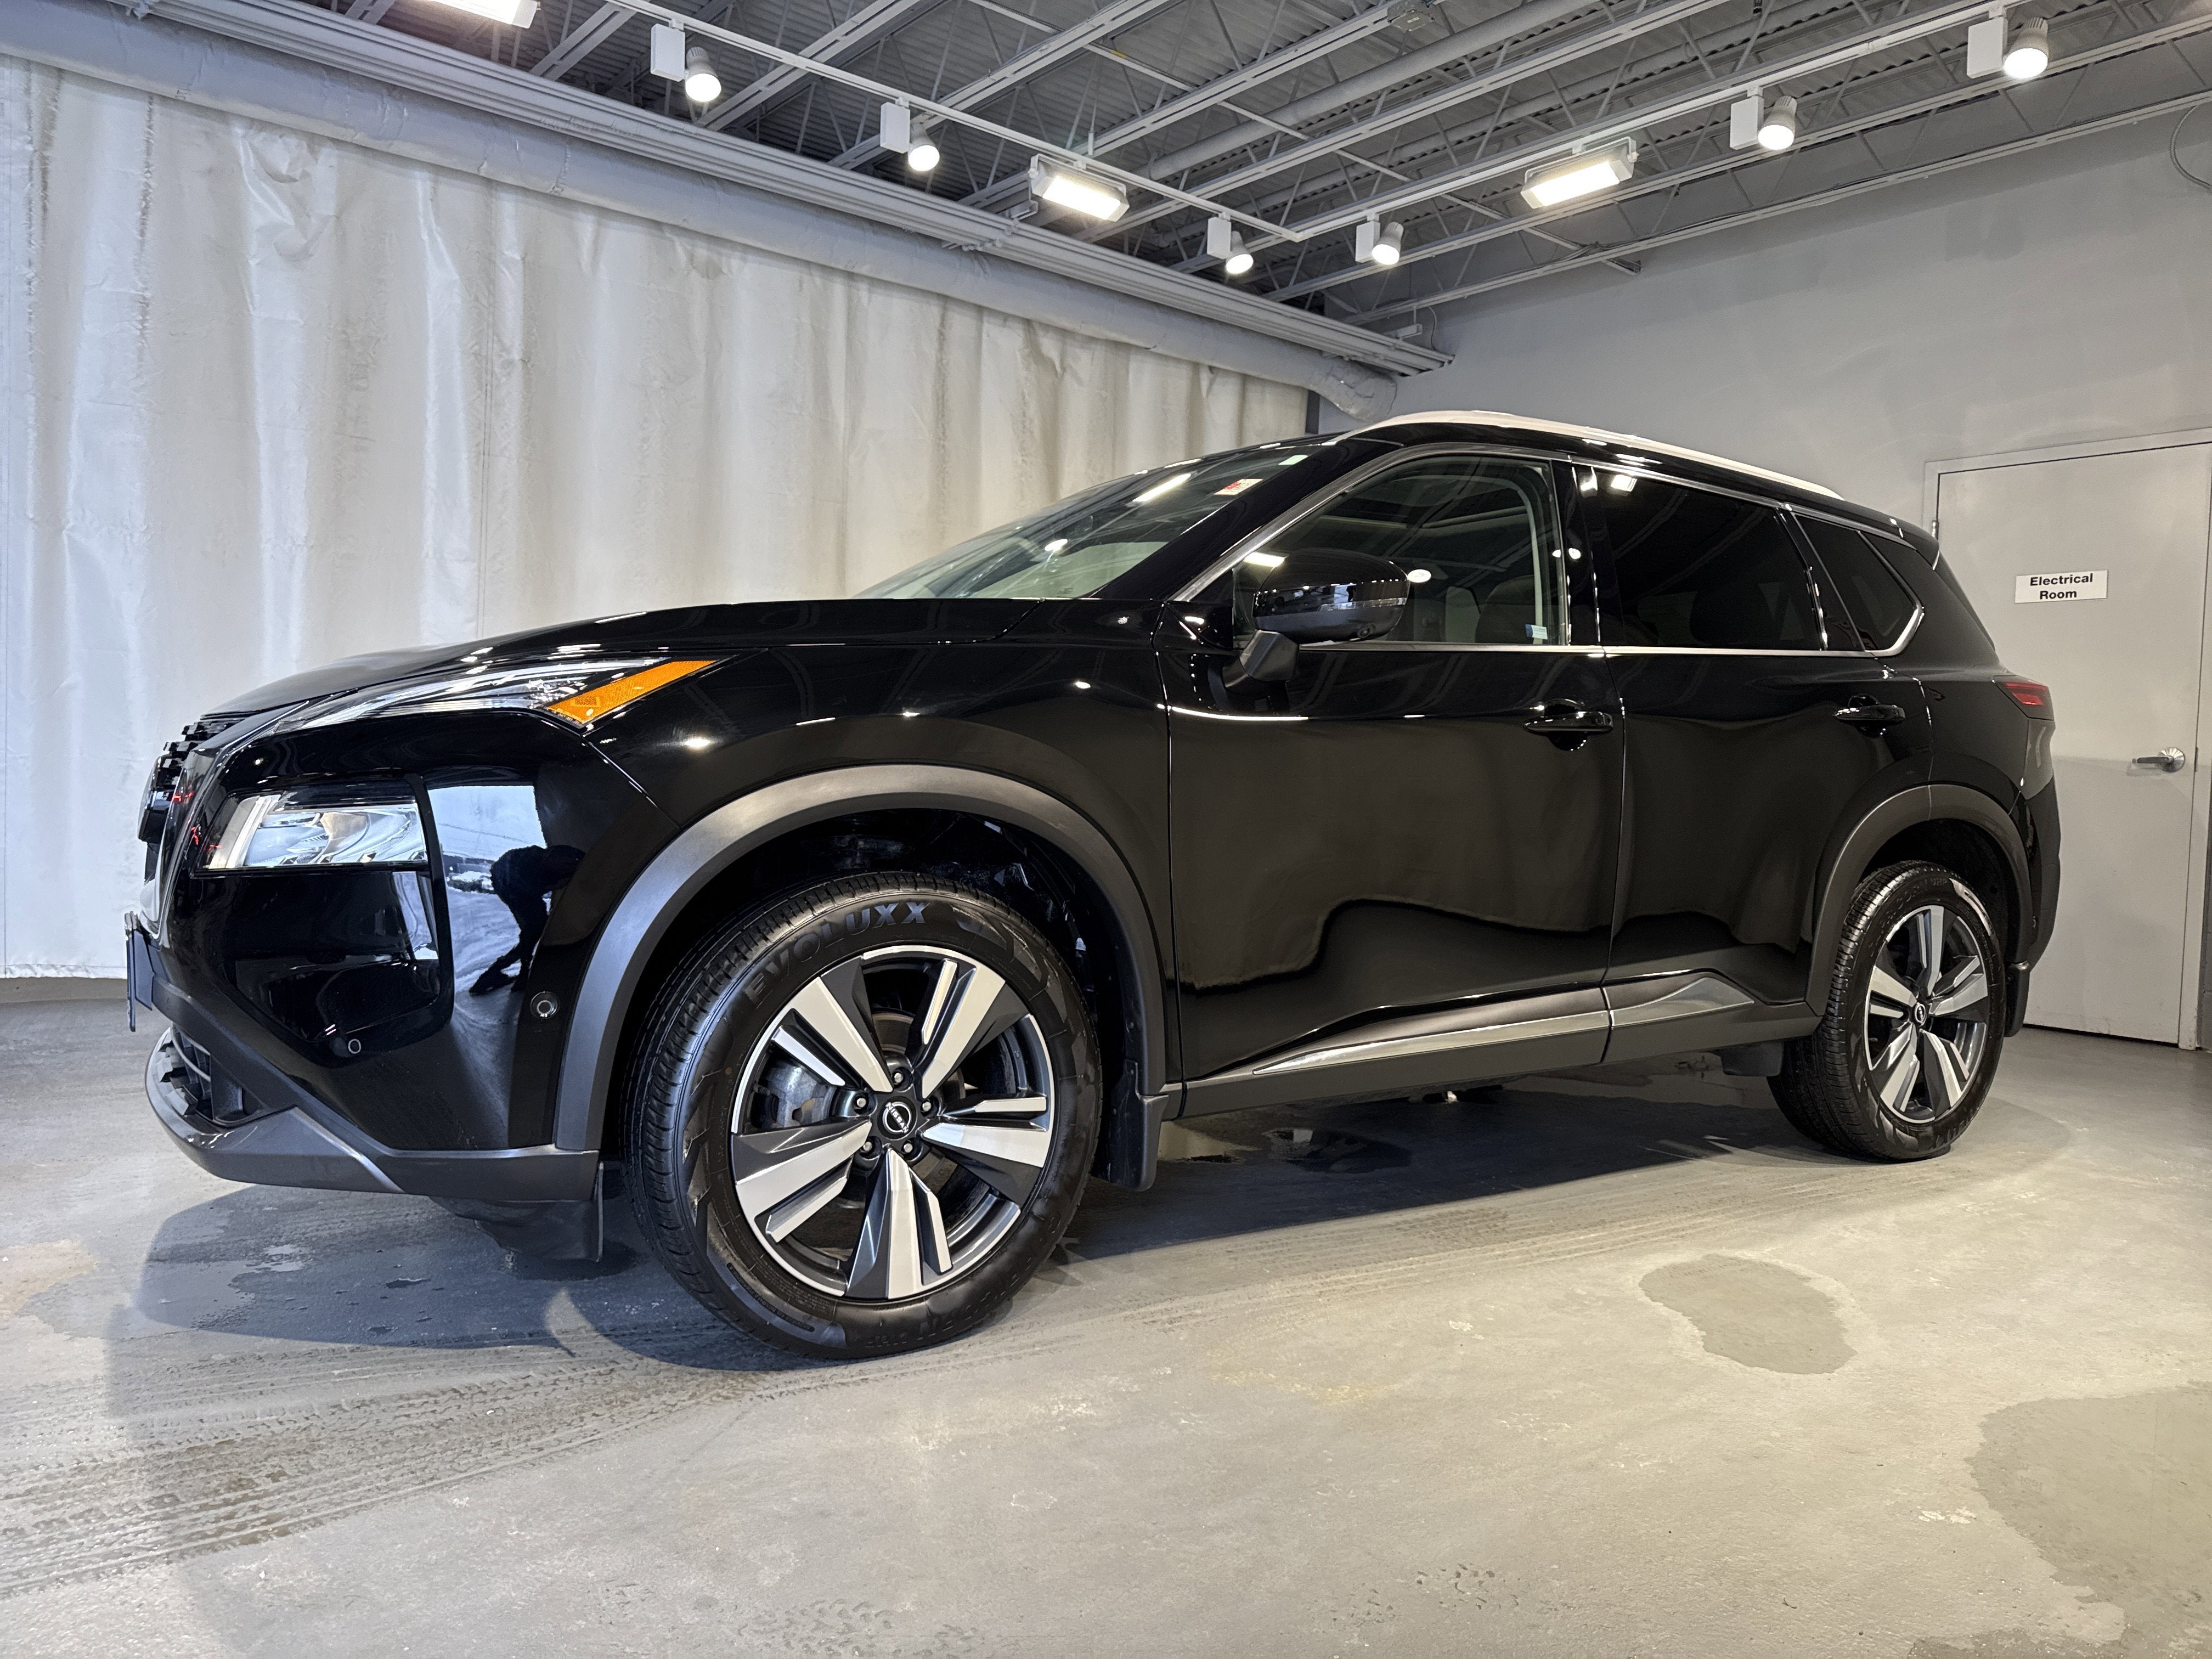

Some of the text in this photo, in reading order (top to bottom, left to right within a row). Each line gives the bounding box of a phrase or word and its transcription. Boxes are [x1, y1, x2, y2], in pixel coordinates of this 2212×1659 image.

[2030, 573, 2093, 586] Electrical
[2039, 590, 2077, 600] Room
[744, 902, 930, 1009] EVOLUXX
[885, 1101, 909, 1133] NISSAN
